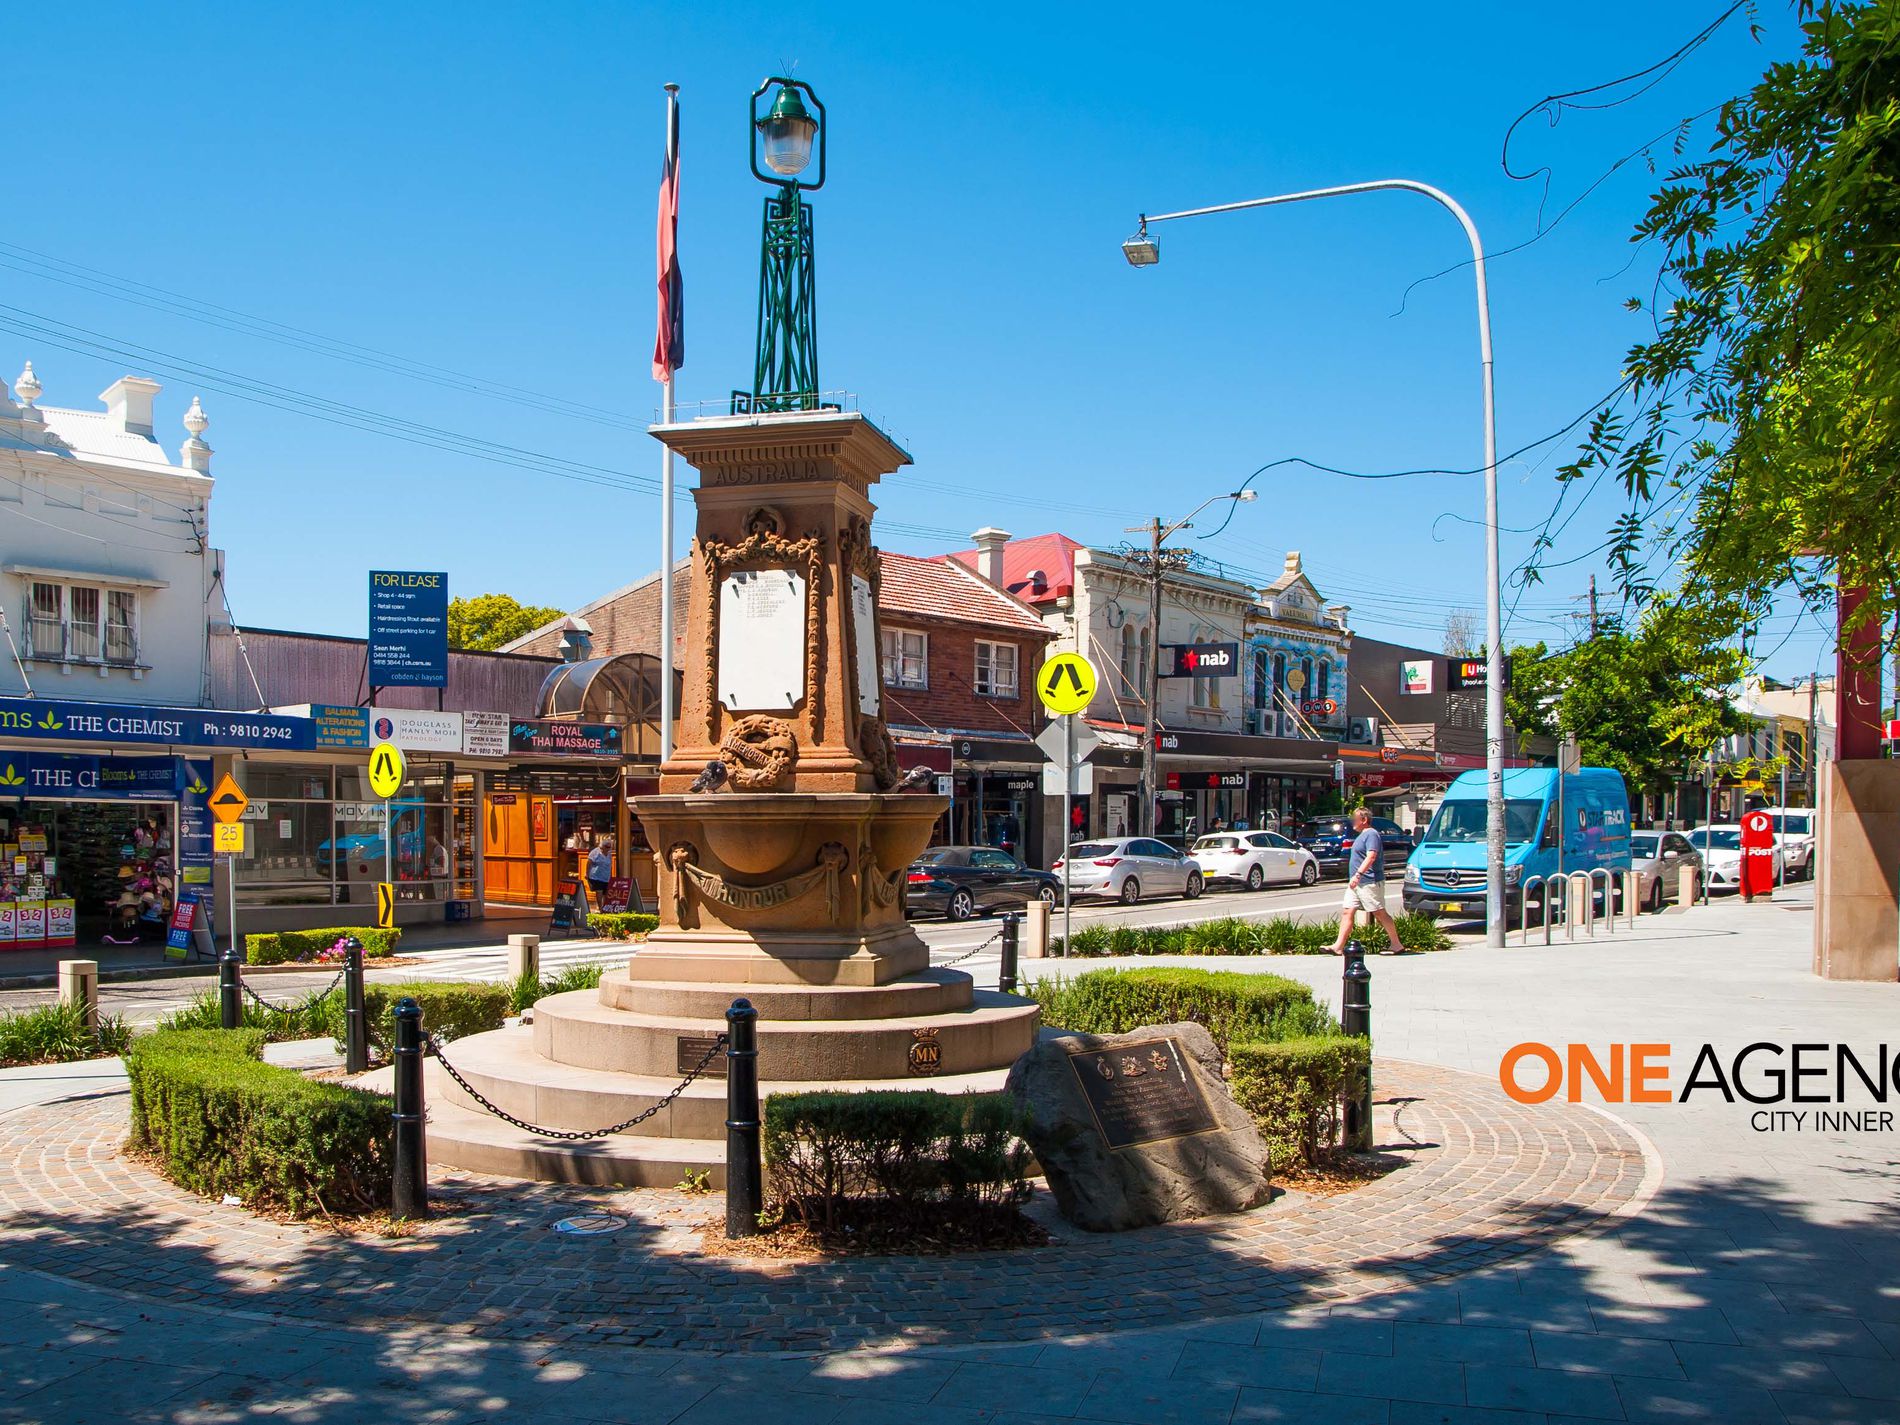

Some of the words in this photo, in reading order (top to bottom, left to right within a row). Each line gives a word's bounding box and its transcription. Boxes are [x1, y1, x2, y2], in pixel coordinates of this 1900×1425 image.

[716, 460, 820, 485] AUSTRALIA
[374, 574, 400, 587] FOR
[401, 575, 441, 588] LEASE
[1200, 650, 1229, 666] nab
[391, 673, 414, 681] cobden
[421, 674, 444, 683] hayson
[324, 707, 359, 716] BALMAIN
[1304, 703, 1331, 711] BWS
[67, 715, 103, 732] THE
[107, 717, 183, 737] CHEMIST
[316, 717, 366, 728] ALTERATIONS
[402, 719, 452, 729] DOUGLASS
[203, 723, 219, 736] Ph
[229, 724, 260, 738] 9810
[262, 726, 292, 740] 2942
[322, 728, 329, 736] &
[330, 728, 362, 737] FASHION
[434, 729, 457, 737] MOIR
[551, 725, 583, 737] ROYAL
[531, 736, 553, 746] THAI
[556, 737, 601, 749] MASSAGE
[1162, 737, 1178, 748] nab
[31, 768, 73, 788] THE
[102, 768, 128, 781] Blooms
[148, 769, 173, 780] CHEMIST
[1221, 774, 1244, 785] nab
[1007, 780, 1034, 791] maple
[221, 826, 238, 841] 25
[1070, 830, 1085, 841] nab
[1748, 848, 1772, 856] POST
[607, 889, 629, 900] SALE
[178, 903, 194, 915] FREE
[171, 930, 188, 942] FREE
[916, 1046, 938, 1063] MN
